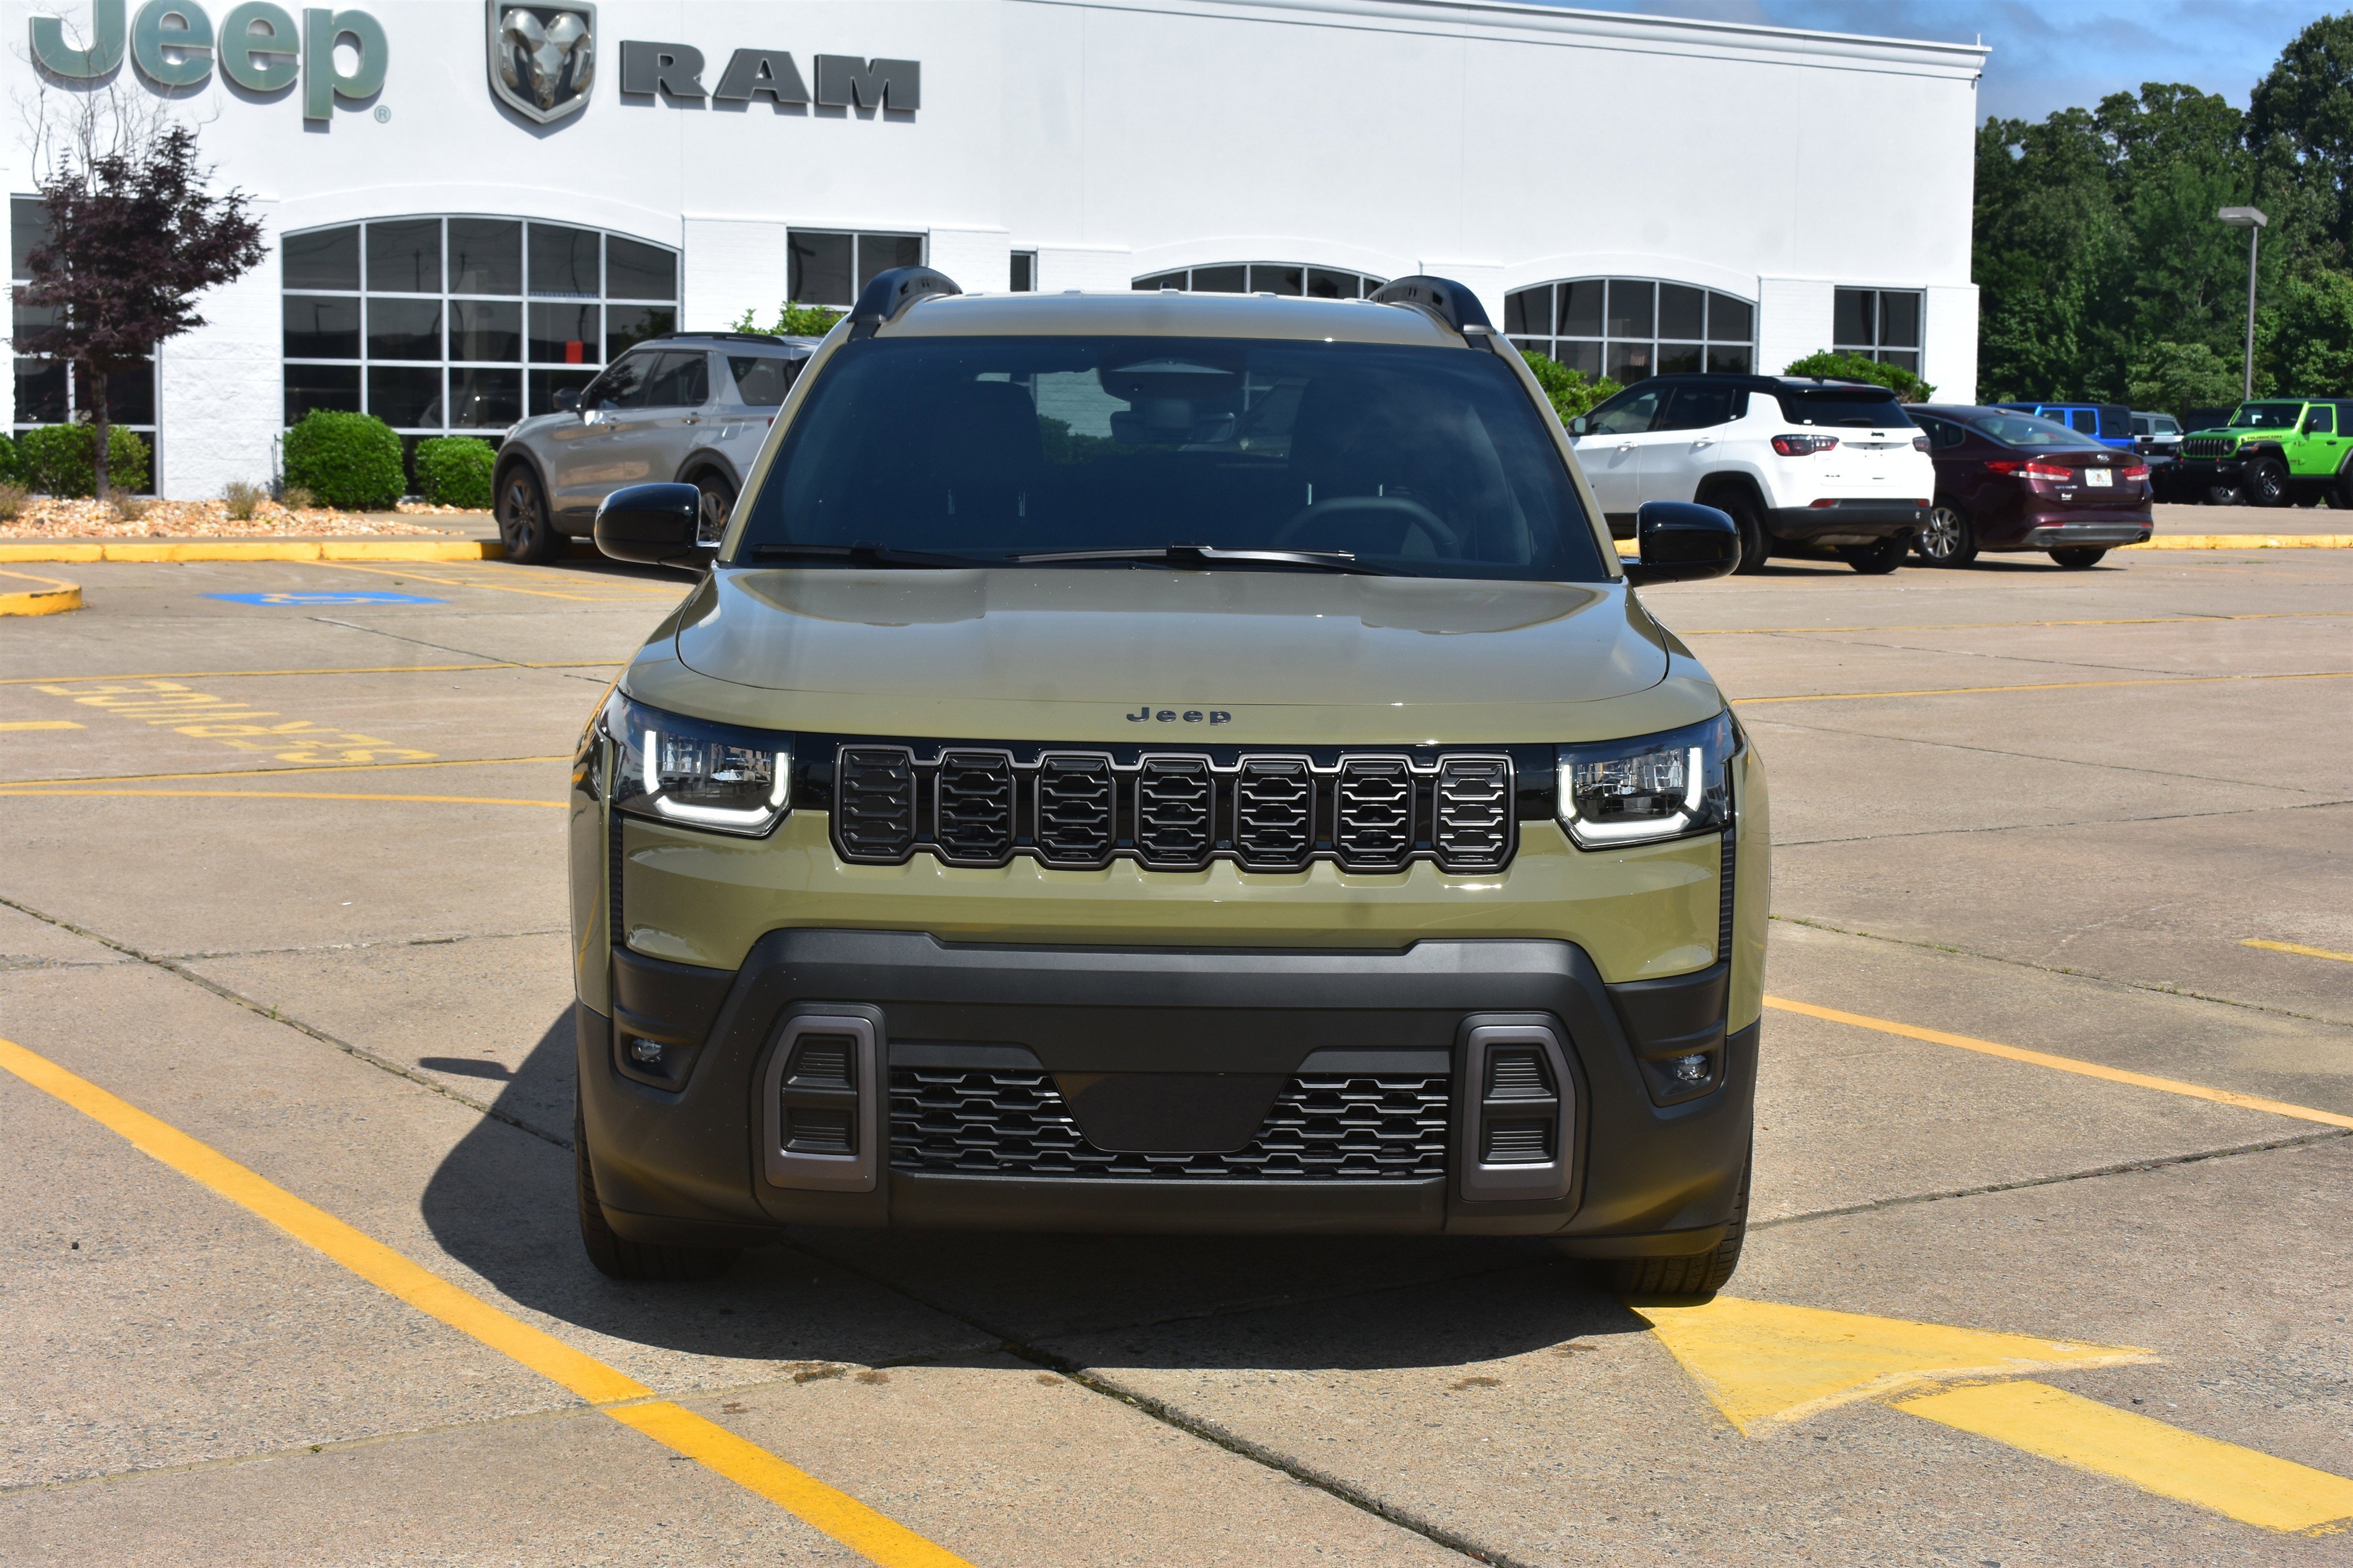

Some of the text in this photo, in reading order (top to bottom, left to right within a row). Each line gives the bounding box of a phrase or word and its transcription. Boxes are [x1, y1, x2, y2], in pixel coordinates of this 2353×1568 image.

[30, 0, 389, 120] Jeep
[620, 40, 921, 110] RAM
[32, 680, 440, 764] SERVICE
[1126, 706, 1232, 726] Jeep
